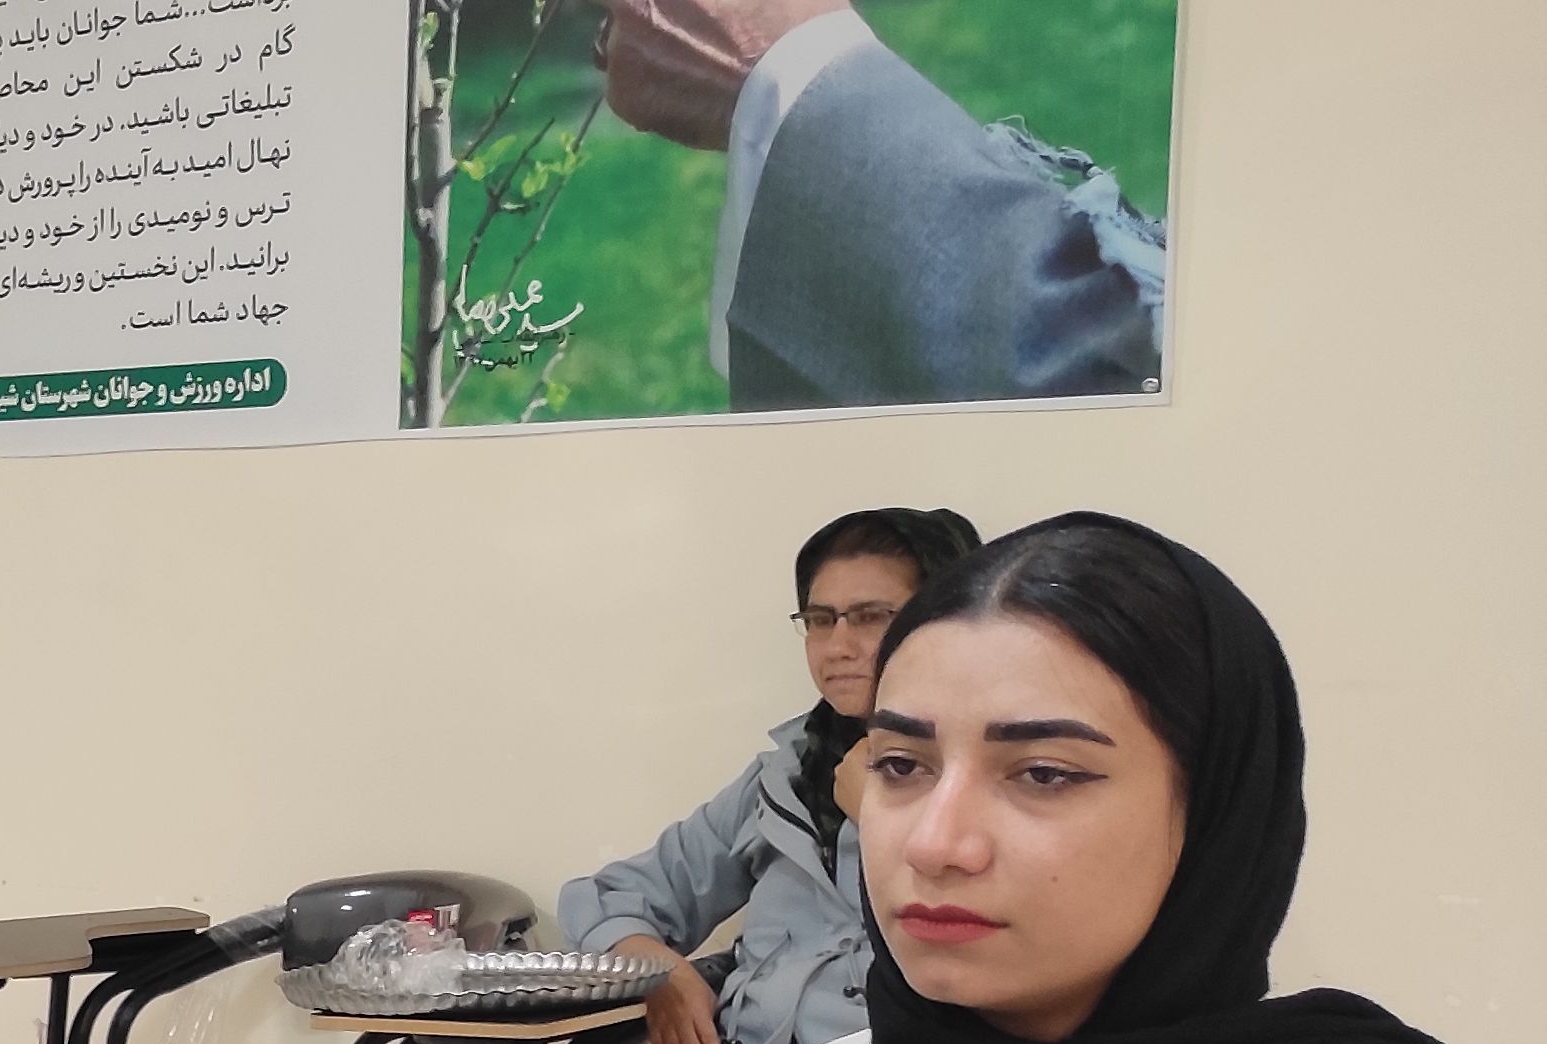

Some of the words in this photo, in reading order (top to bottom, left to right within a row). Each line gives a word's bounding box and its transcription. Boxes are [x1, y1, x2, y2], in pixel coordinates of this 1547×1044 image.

[9, 17, 50, 51] باید
[57, 7, 127, 45] جوانان
[215, 44, 242, 73] در
[259, 23, 296, 72] گام
[63, 58, 101, 97] این
[115, 44, 203, 89] شکستن
[120, 96, 190, 135] باشید.
[197, 83, 292, 129] تبلیغاتی
[23, 130, 36, 151] و
[41, 114, 87, 148] خود
[89, 116, 114, 142] در
[94, 147, 152, 187] آینده
[152, 158, 179, 182] به
[182, 141, 233, 178] امید
[237, 137, 291, 174] نهال
[8, 172, 76, 204] پرورش
[78, 160, 91, 193] را
[86, 208, 105, 242] از
[110, 206, 122, 240] را
[128, 199, 211, 237] نومیدی
[214, 206, 229, 228] و
[235, 192, 292, 228] ترس
[22, 228, 35, 249] و
[39, 214, 85, 247] خود
[89, 255, 178, 292] نخستین
[181, 246, 215, 284] این
[219, 241, 290, 276] برانید.
[72, 272, 85, 292] و
[121, 300, 181, 330] است.
[188, 299, 230, 324] شما
[235, 294, 289, 326] جهاد
[20, 379, 92, 412] شهرستان
[93, 376, 154, 408] جوانان
[155, 383, 168, 406] و
[170, 371, 223, 405] ورزش
[224, 366, 272, 403] اداره
